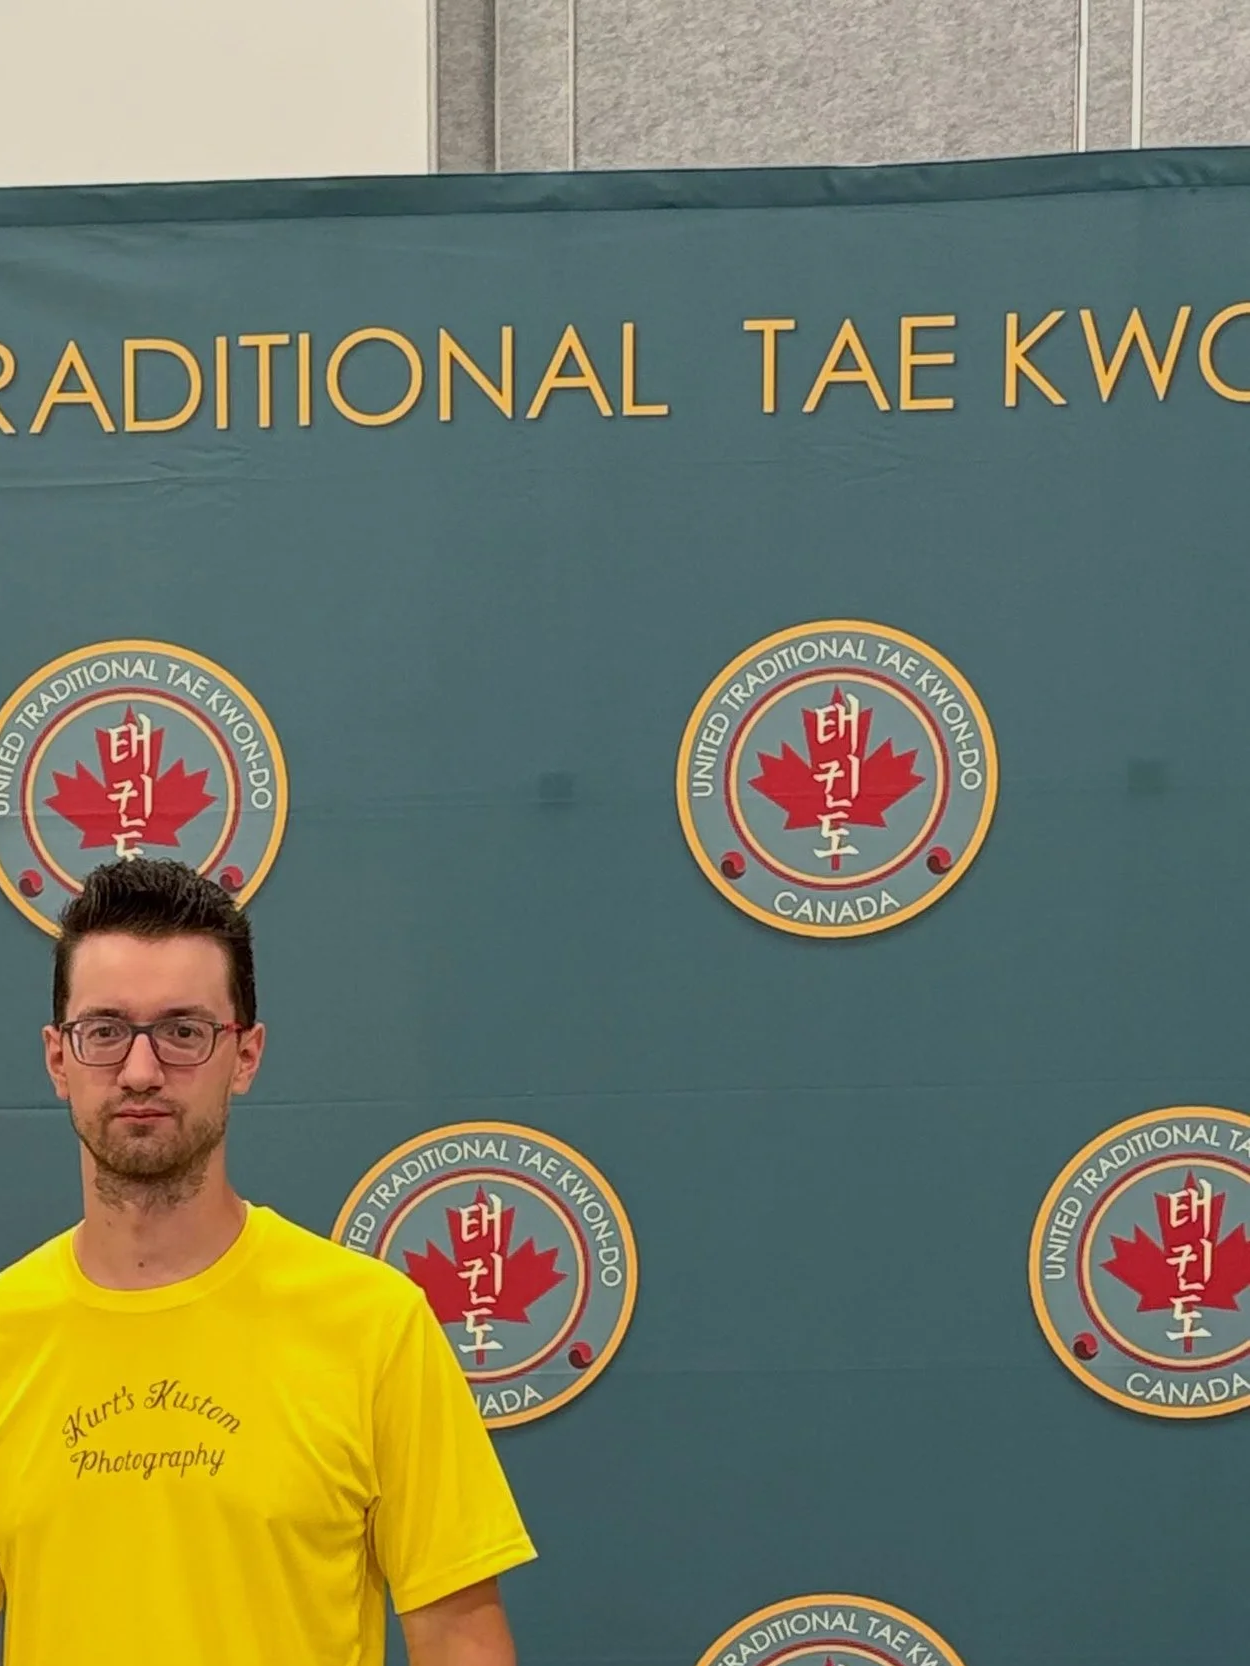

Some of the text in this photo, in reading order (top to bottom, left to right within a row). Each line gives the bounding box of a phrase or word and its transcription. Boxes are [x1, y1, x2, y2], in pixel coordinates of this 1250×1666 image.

[743, 314, 956, 414] TAE
[1003, 301, 1250, 407] KWO
[15, 657, 159, 731] TRADITIONAL
[167, 662, 210, 700] TAE
[206, 688, 273, 810] KWON-DO
[692, 637, 982, 797] UNITED TRADITIONAL TAE KWON-DO
[773, 890, 900, 924] CANADA
[345, 1139, 622, 1288] TED TRADITIONAL TAE KWON-DO
[1044, 1196, 1082, 1280] UNITED
[1073, 1123, 1221, 1196] TRADITIONAL
[62, 1379, 241, 1449] Kurt's Kustom
[476, 1383, 544, 1416] ADA
[1126, 1371, 1250, 1406] CANADA
[70, 1442, 225, 1481] Photography
[866, 1616, 910, 1652] TAE
